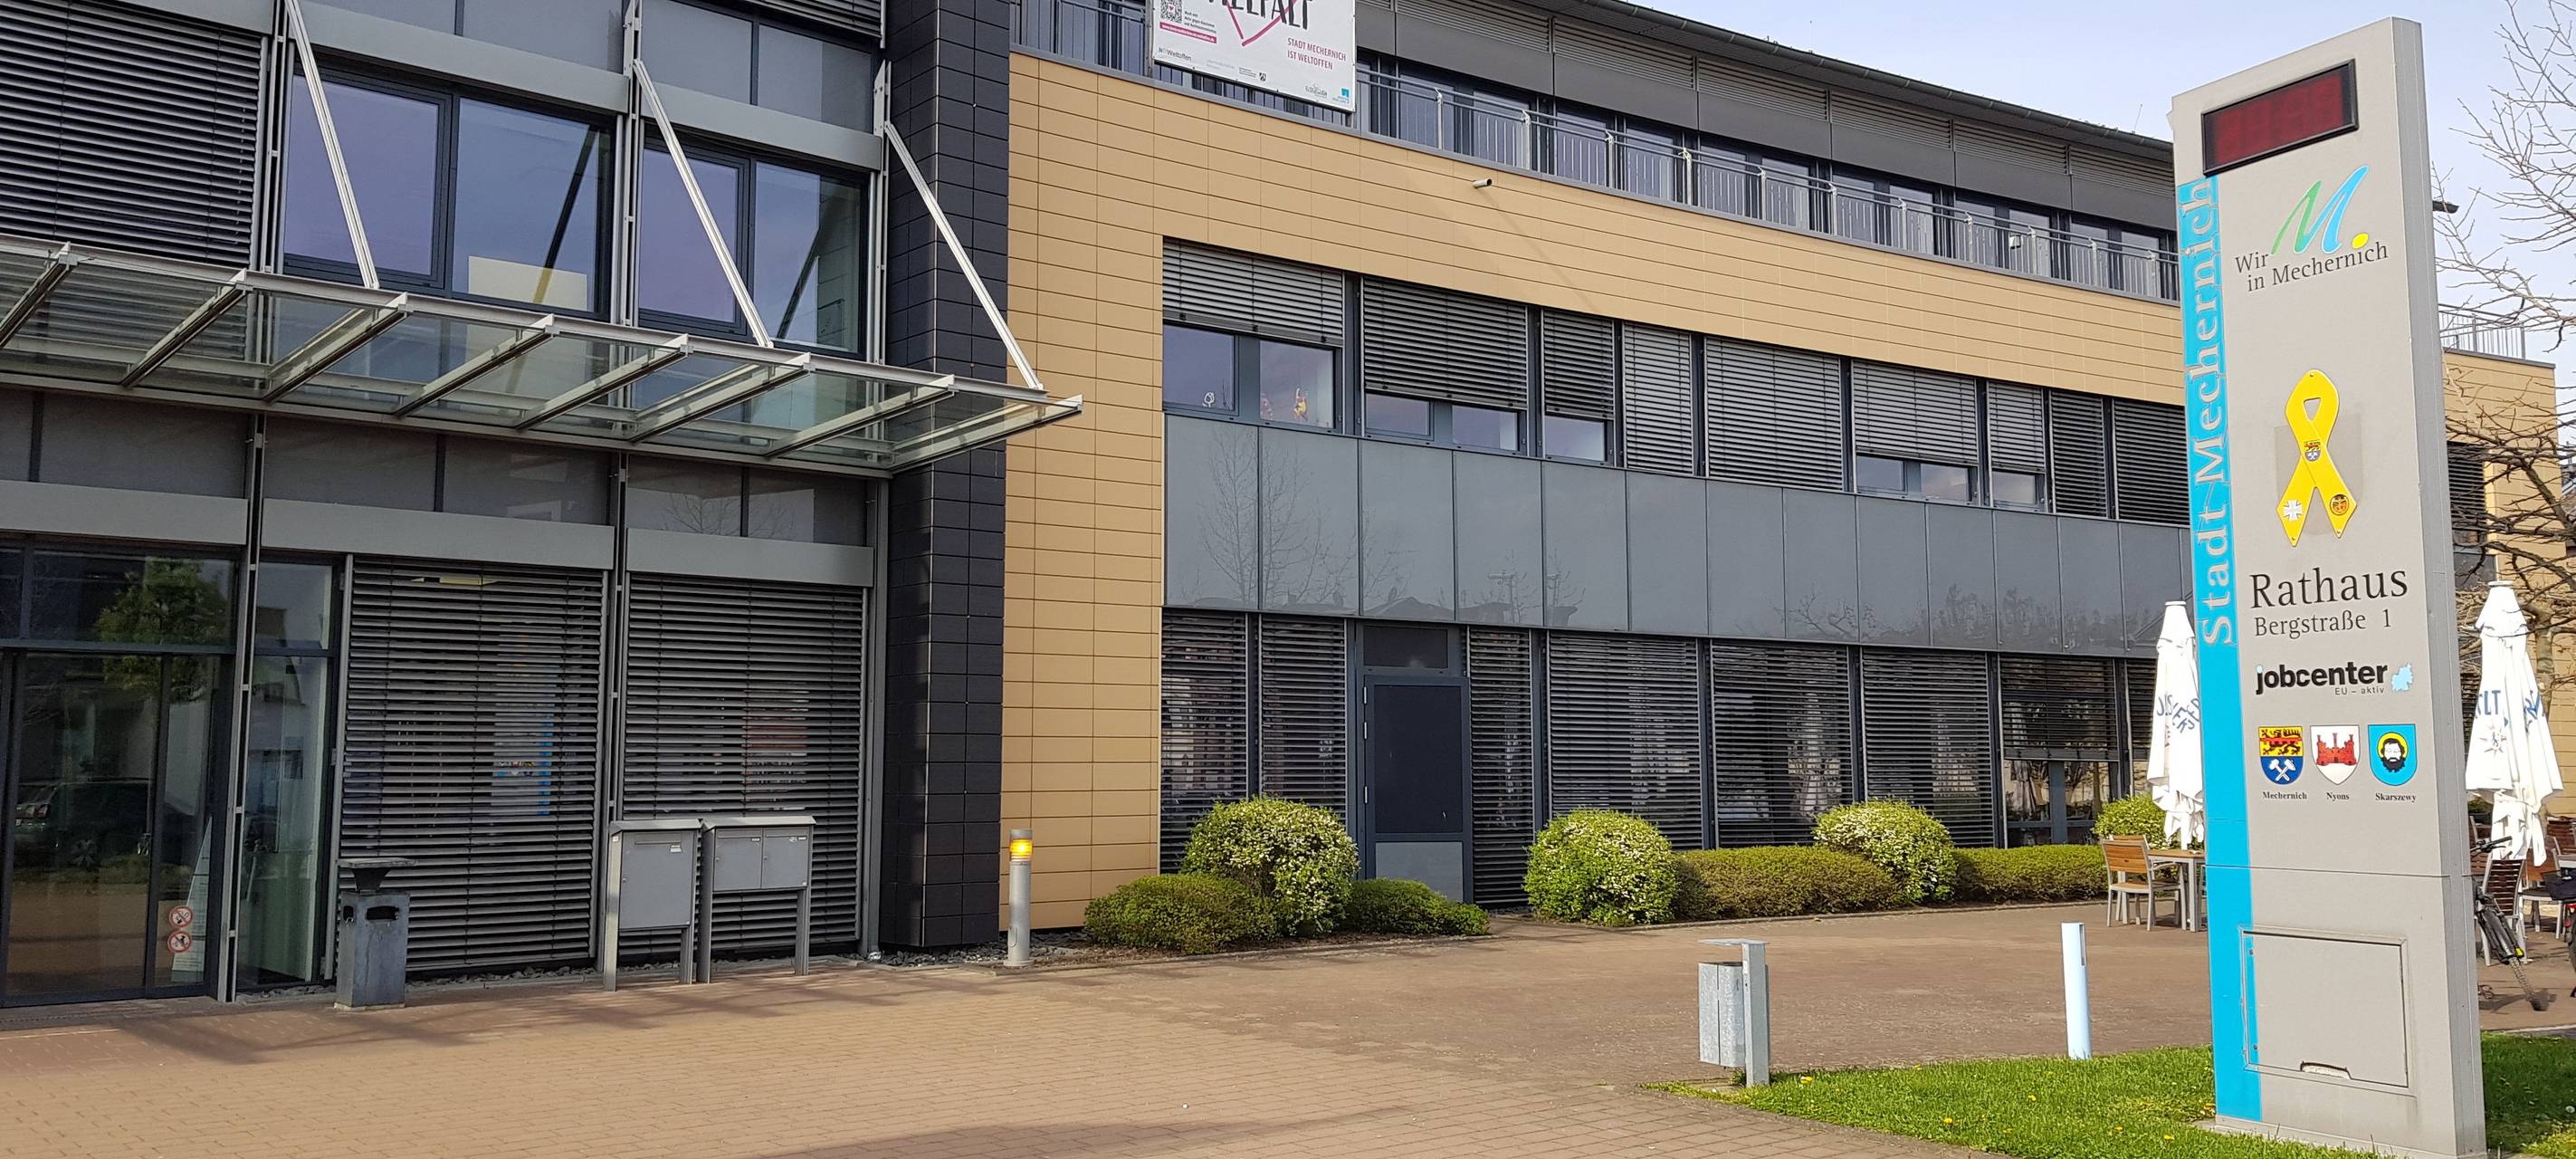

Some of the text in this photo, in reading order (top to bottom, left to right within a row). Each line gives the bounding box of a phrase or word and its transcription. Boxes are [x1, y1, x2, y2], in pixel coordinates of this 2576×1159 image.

[1287, 37, 1347, 62] STADT MECHERNICH
[1287, 50, 1333, 70] IST WELTOFFEN
[2235, 251, 2269, 273] Wir
[2246, 241, 2389, 292] in Mechernich
[2181, 179, 2233, 646] Stadt Mechernich
[2249, 567, 2409, 609] Rathaus
[2255, 608, 2392, 639] Bergstraße 1
[2255, 662, 2389, 695] jobcenter
[2334, 687, 2348, 696] EU
[2361, 686, 2385, 694] aktiv
[2262, 791, 2307, 800] Mechernich
[2326, 791, 2350, 802] Nyons
[2375, 792, 2417, 803] Skarszewy
